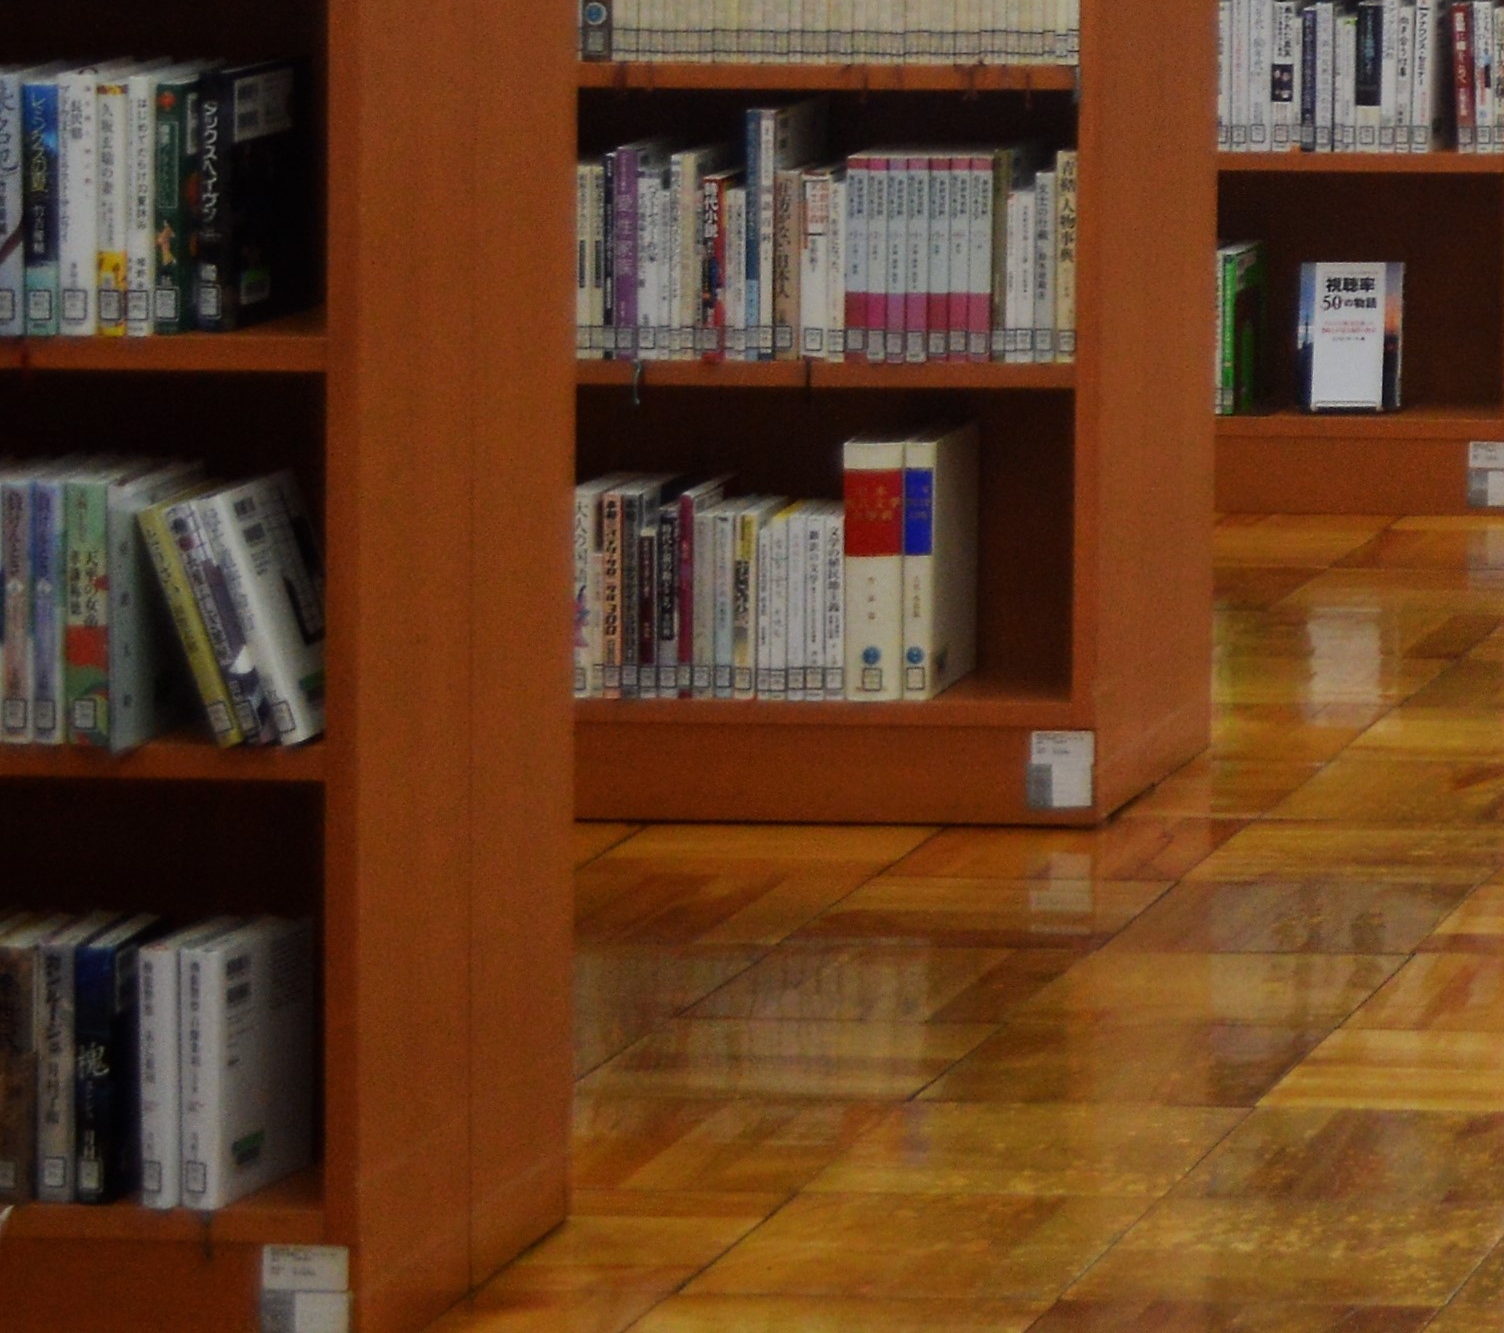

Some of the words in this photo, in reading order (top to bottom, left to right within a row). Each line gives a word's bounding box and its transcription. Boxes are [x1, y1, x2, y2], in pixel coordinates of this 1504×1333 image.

[1325, 276, 1377, 294] 視聴率
[1321, 295, 1379, 312] 50の物語
